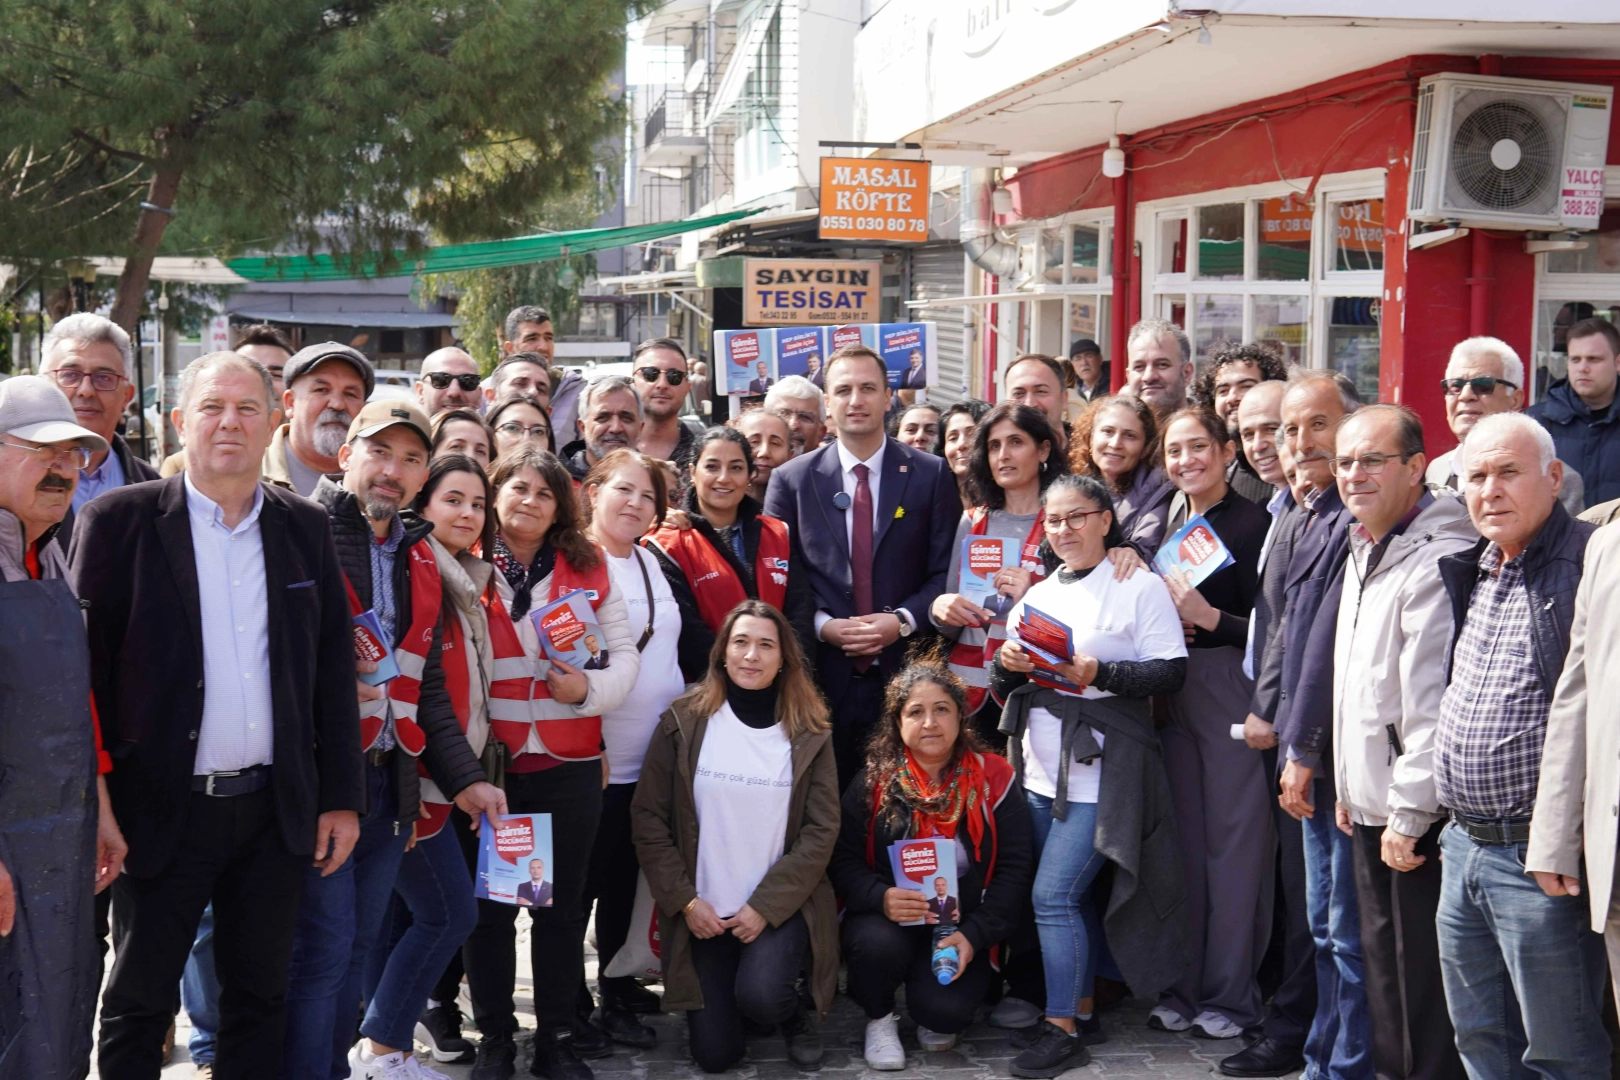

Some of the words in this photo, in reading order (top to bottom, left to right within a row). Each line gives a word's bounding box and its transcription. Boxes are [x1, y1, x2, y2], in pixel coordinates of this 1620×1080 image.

[831, 166, 917, 188] MASAL
[835, 188, 912, 212] KÖFTE
[1564, 200, 1583, 215] 388
[821, 215, 853, 230] 0551
[856, 216, 884, 230] 030
[887, 217, 906, 232] 80
[908, 218, 926, 232] 78
[756, 269, 869, 287] SAYGIN
[757, 286, 867, 309] TESİSAT
